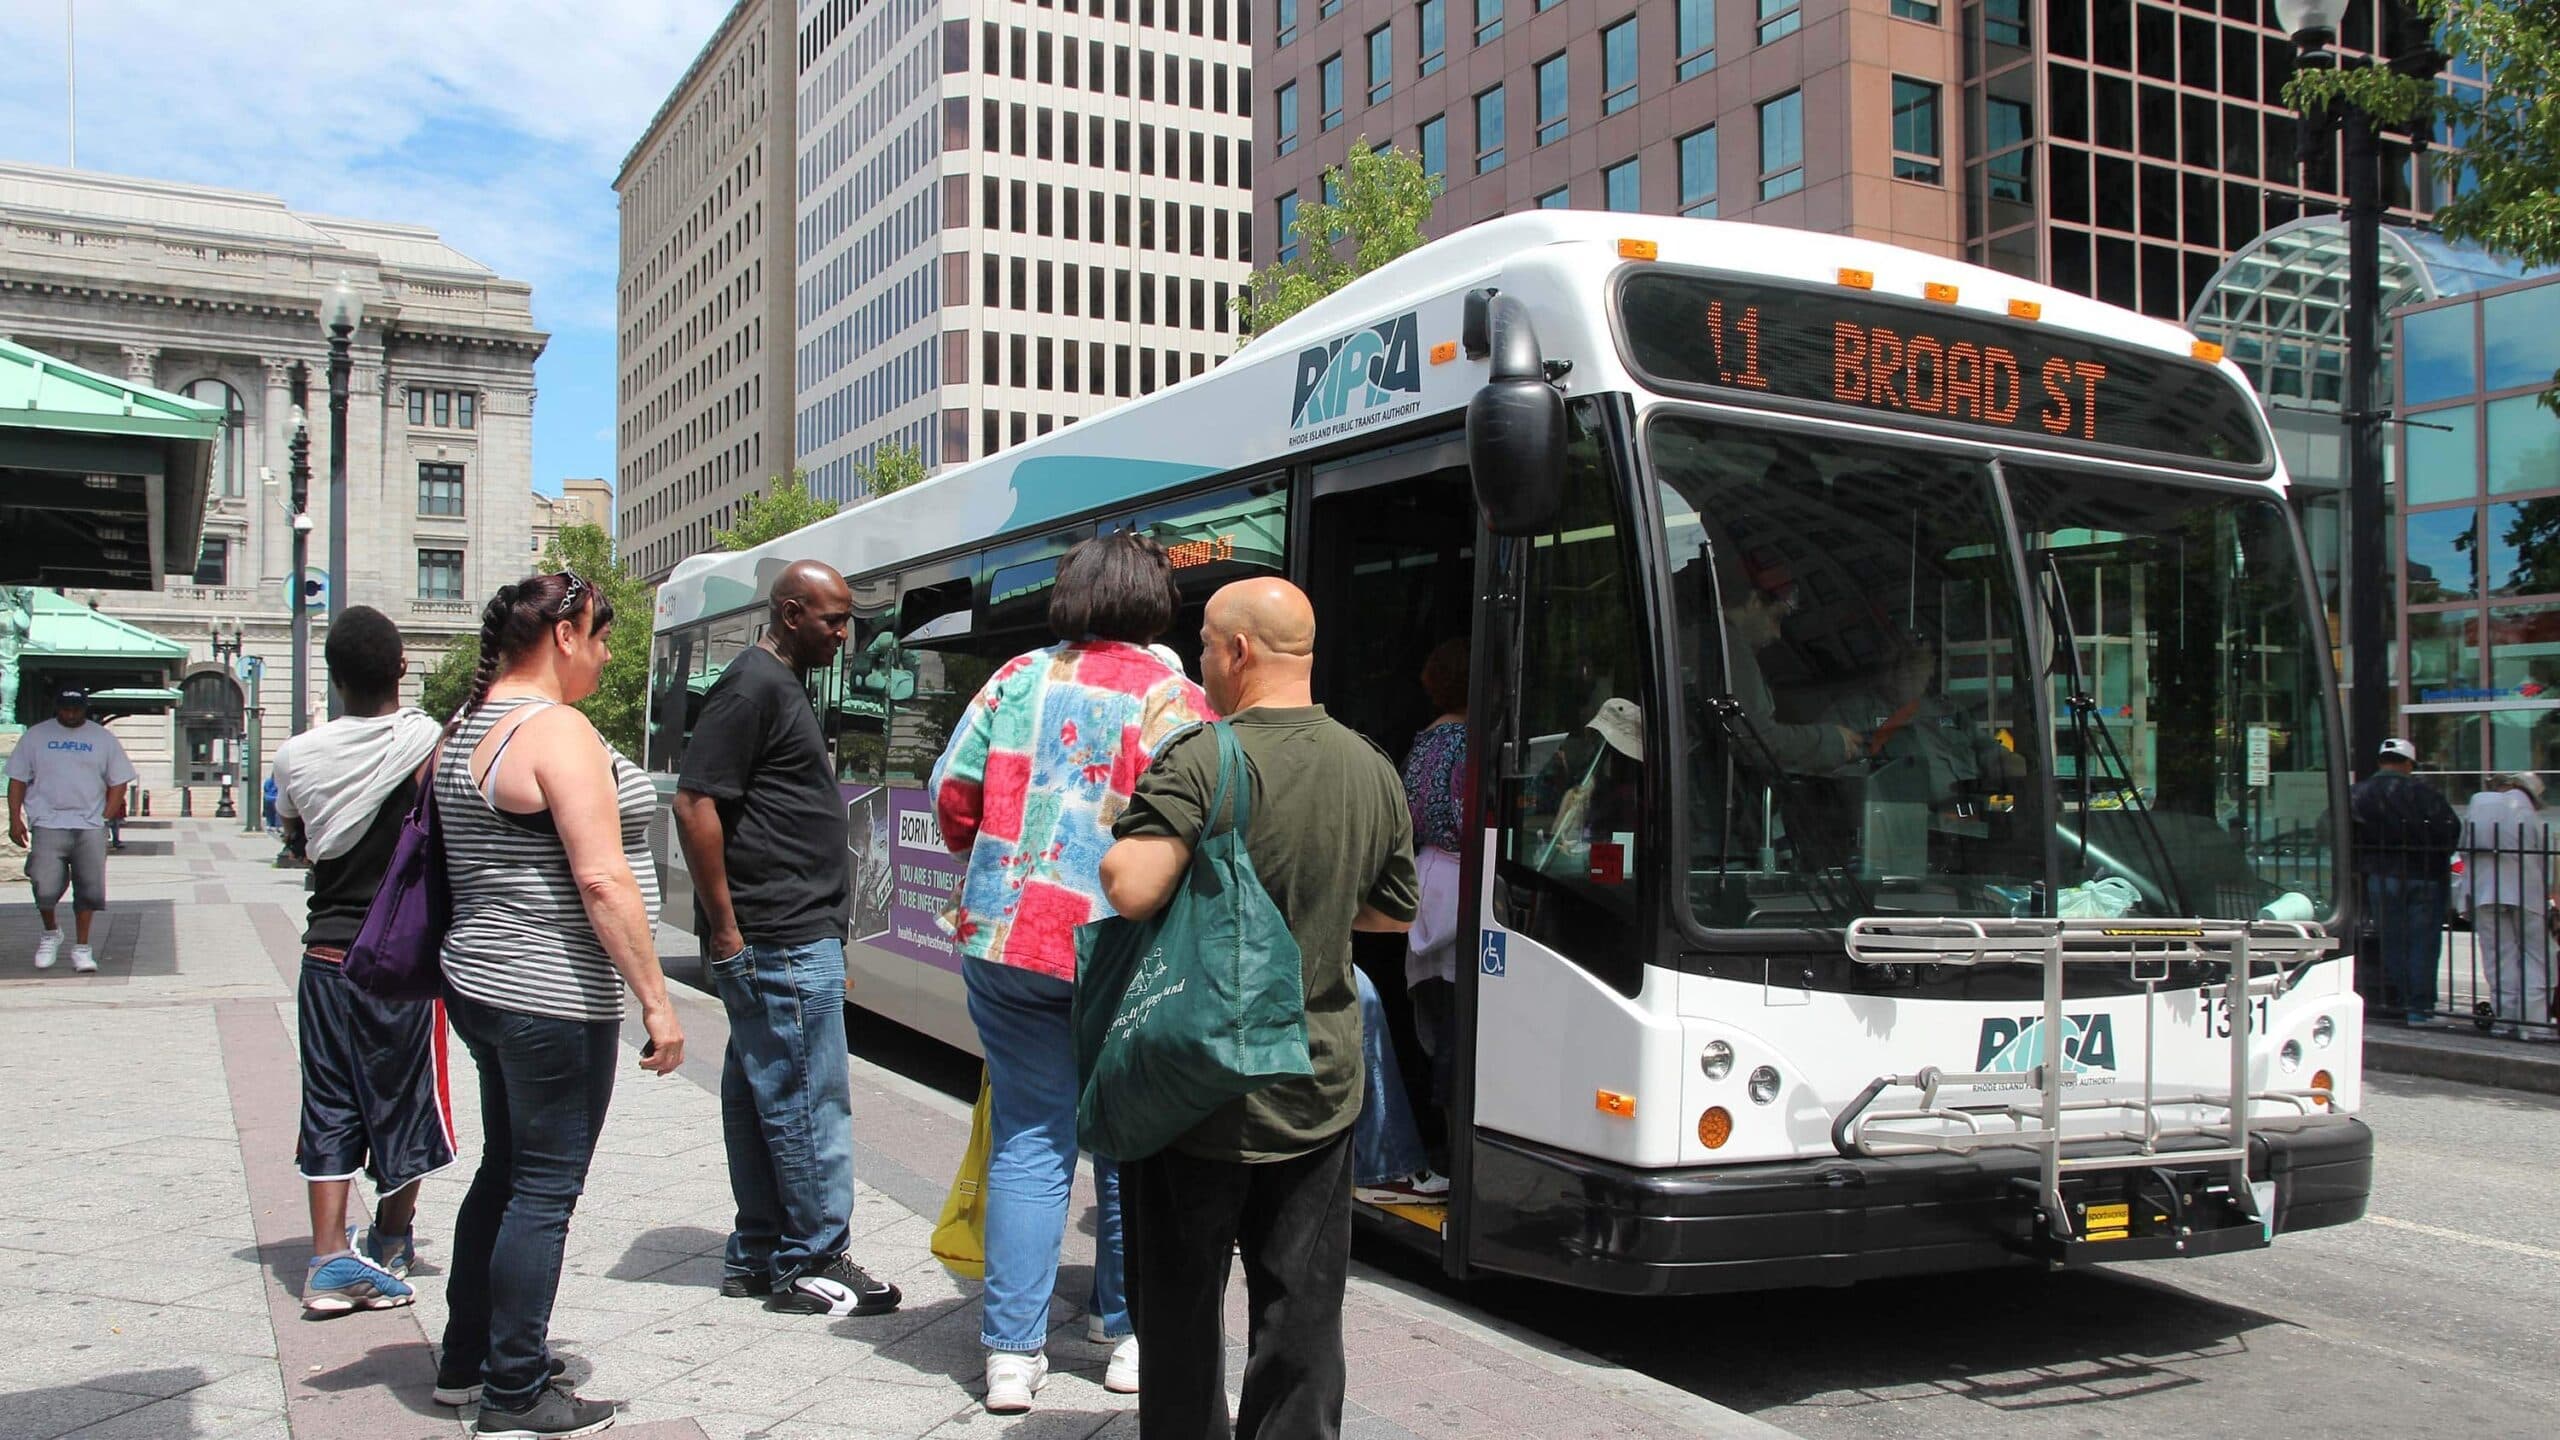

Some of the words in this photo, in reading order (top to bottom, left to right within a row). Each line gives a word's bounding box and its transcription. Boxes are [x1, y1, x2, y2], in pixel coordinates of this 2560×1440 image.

[1832, 321, 2020, 426] BROAD
[2041, 358, 2106, 440] ST
[1289, 434, 1309, 447] RHODE
[1309, 427, 1331, 440] ISLAND
[1332, 422, 1354, 435] PUBLIC
[1355, 412, 1381, 428] TRANSIT
[1382, 400, 1421, 420] AUTHORITY
[1216, 534, 1235, 560] ST
[901, 816, 928, 843] BORN
[899, 864, 912, 882] YOU
[912, 867, 926, 887] ARE
[927, 869, 932, 887] 5
[933, 870, 953, 892] TIMES
[898, 888, 908, 906] TO
[908, 892, 917, 909] BE
[1972, 1083, 1997, 1093] RHODE
[1998, 1082, 2023, 1092] ISLAND
[2080, 1077, 2117, 1087] AUTHORITY
